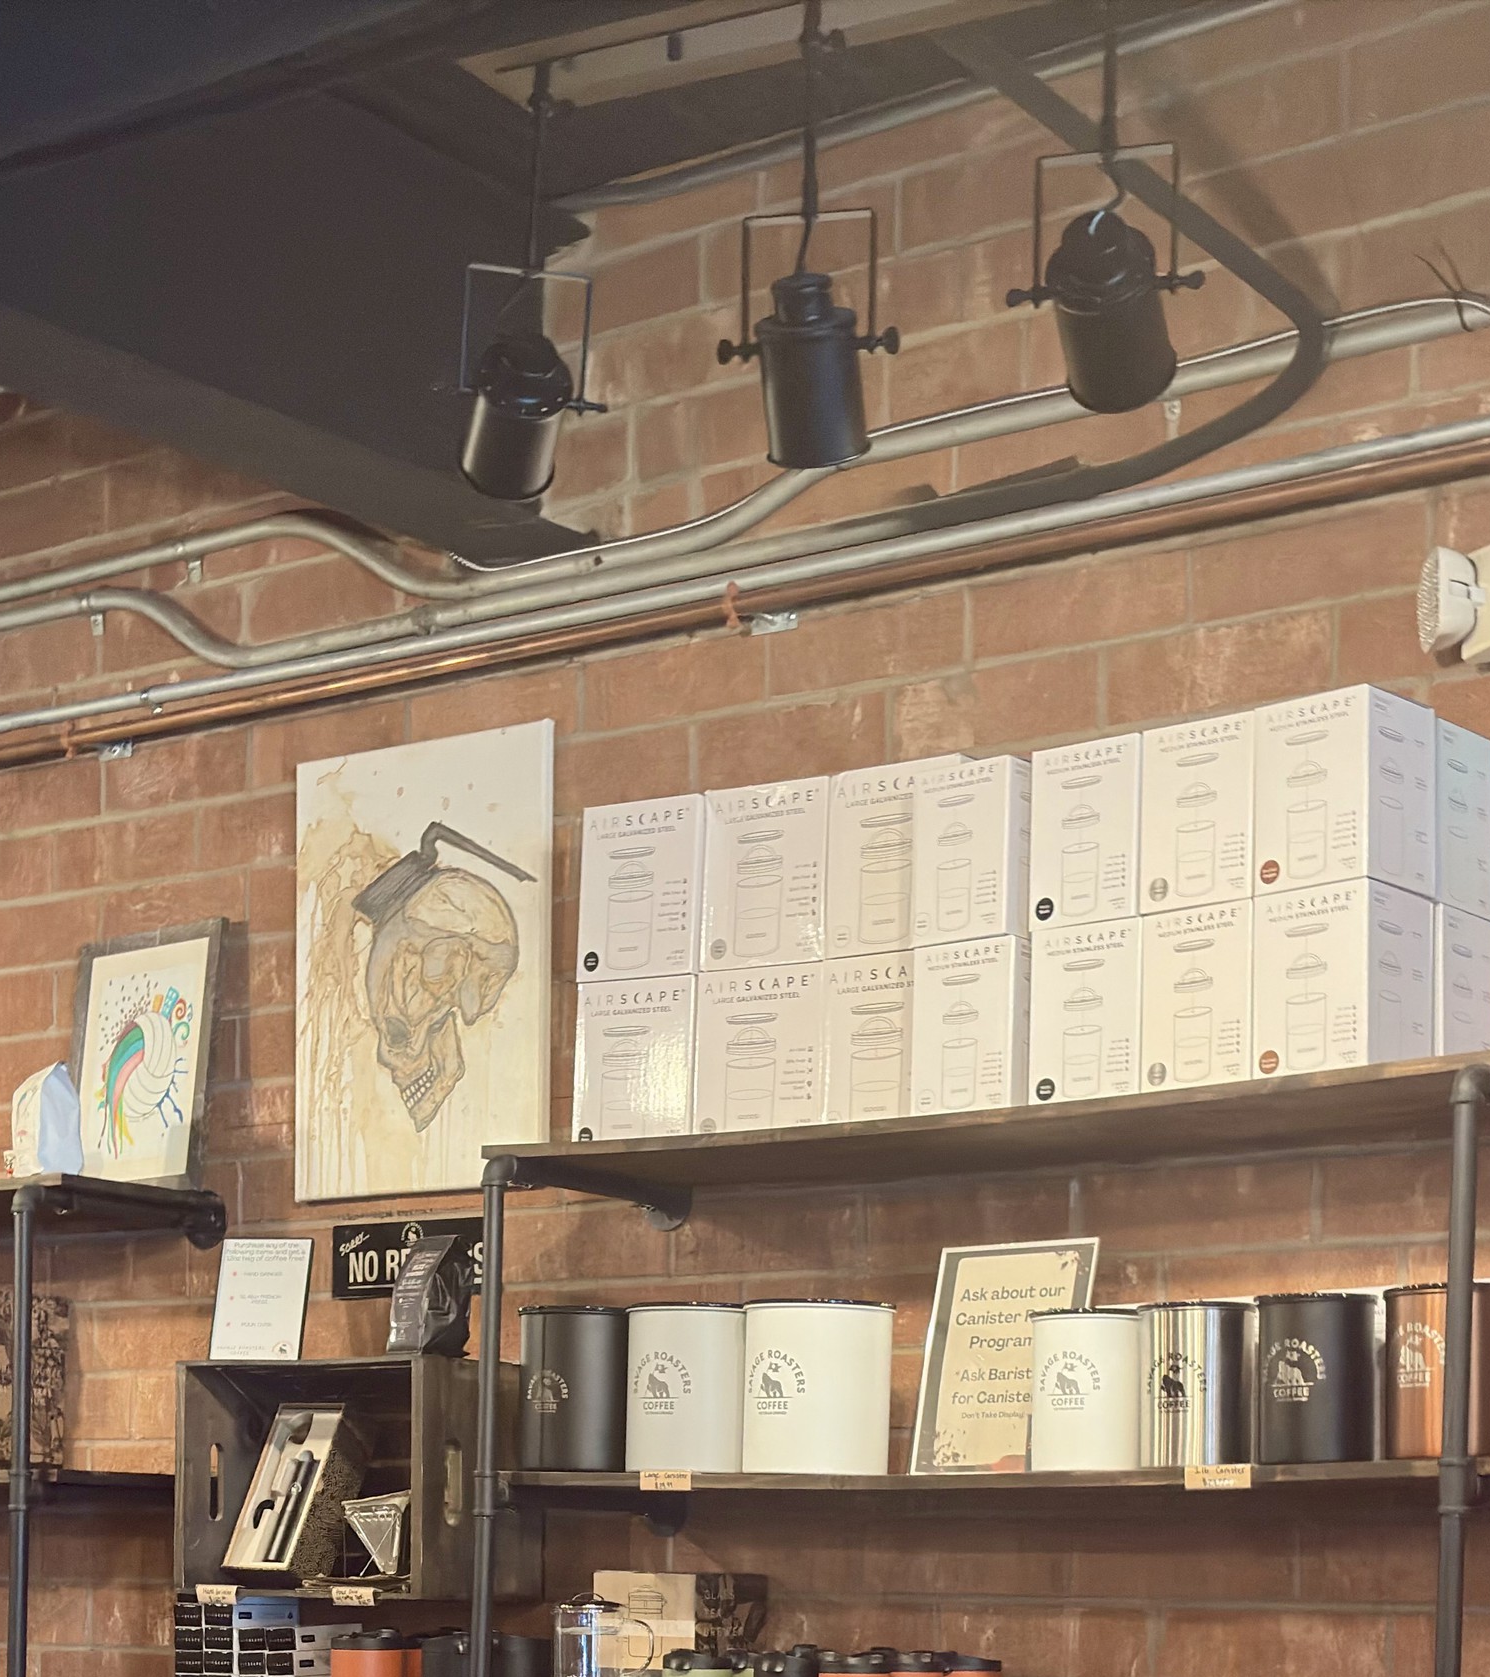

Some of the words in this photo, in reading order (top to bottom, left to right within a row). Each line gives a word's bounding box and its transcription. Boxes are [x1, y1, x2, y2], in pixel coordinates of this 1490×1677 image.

[1267, 696, 1352, 725] AIRSCAPE
[1157, 721, 1242, 745] AIRSCAPE
[1045, 743, 1124, 768] AIRSCAPE
[837, 775, 915, 799] AIRSCA
[590, 808, 685, 832] AIRSCAPE
[1266, 892, 1352, 914] AIRSCAPE
[1157, 907, 1238, 930] AIRSCAPE
[1045, 929, 1126, 949] AIRSCAPE
[925, 944, 1001, 964] AIRSCAPE
[705, 974, 810, 996] AIRSCAPE
[829, 963, 908, 986] AIRSCA
[584, 992, 682, 1008] AIRSCAPE
[348, 1250, 379, 1284] NO
[960, 1287, 987, 1302] Ask
[991, 1285, 1036, 1301] about
[1039, 1286, 1066, 1300] our
[956, 1310, 1022, 1326] Canister
[1284, 1338, 1327, 1381] ROASTERS
[633, 1353, 651, 1394] SAVAGE
[654, 1351, 692, 1394] ROASTERS
[748, 1352, 765, 1394] SAVAGE
[767, 1349, 806, 1394] ROASTERS
[987, 1366, 1032, 1385] Barist
[1040, 1353, 1060, 1392] SAVAGE
[1062, 1351, 1101, 1391] ROASTERS
[952, 1392, 974, 1405] for
[1051, 1397, 1086, 1407] COFFEE
[1273, 1386, 1310, 1398] COFFEE
[642, 1400, 675, 1411] COFFEE
[756, 1400, 789, 1411] COFFEE
[961, 1412, 980, 1420] Don't
[981, 1411, 997, 1419] Take
[1157, 1399, 1192, 1410] COFFEE
